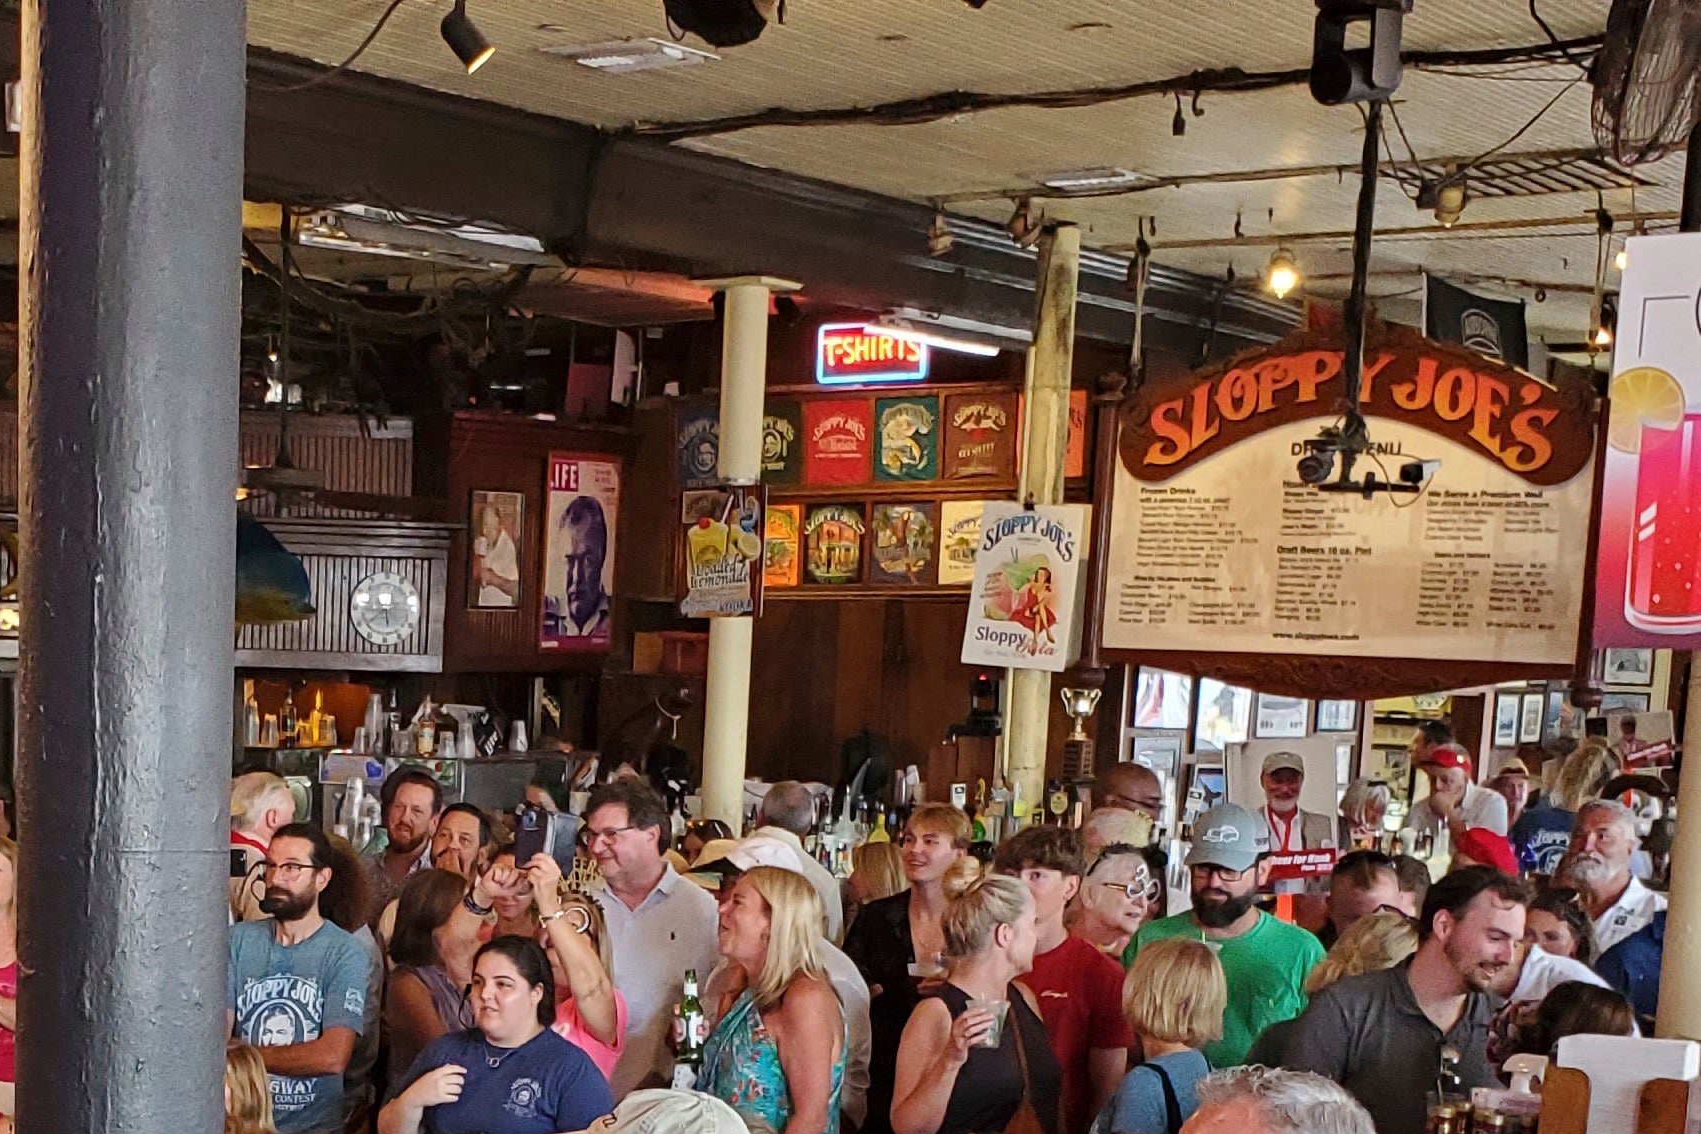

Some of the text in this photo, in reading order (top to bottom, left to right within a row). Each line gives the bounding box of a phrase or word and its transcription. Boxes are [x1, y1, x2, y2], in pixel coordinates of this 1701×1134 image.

[824, 335, 921, 367] T-SHIRTS
[1144, 351, 1560, 472] SLOPPY JOE'S
[812, 416, 846, 441] SLOPPY
[983, 515, 1076, 562] SLOPPY JOE'S
[975, 626, 1027, 647] Sloppy
[237, 978, 294, 1022] SLOPPY
[269, 1078, 317, 1093] GWAY
[274, 1093, 317, 1104] CONTEST
